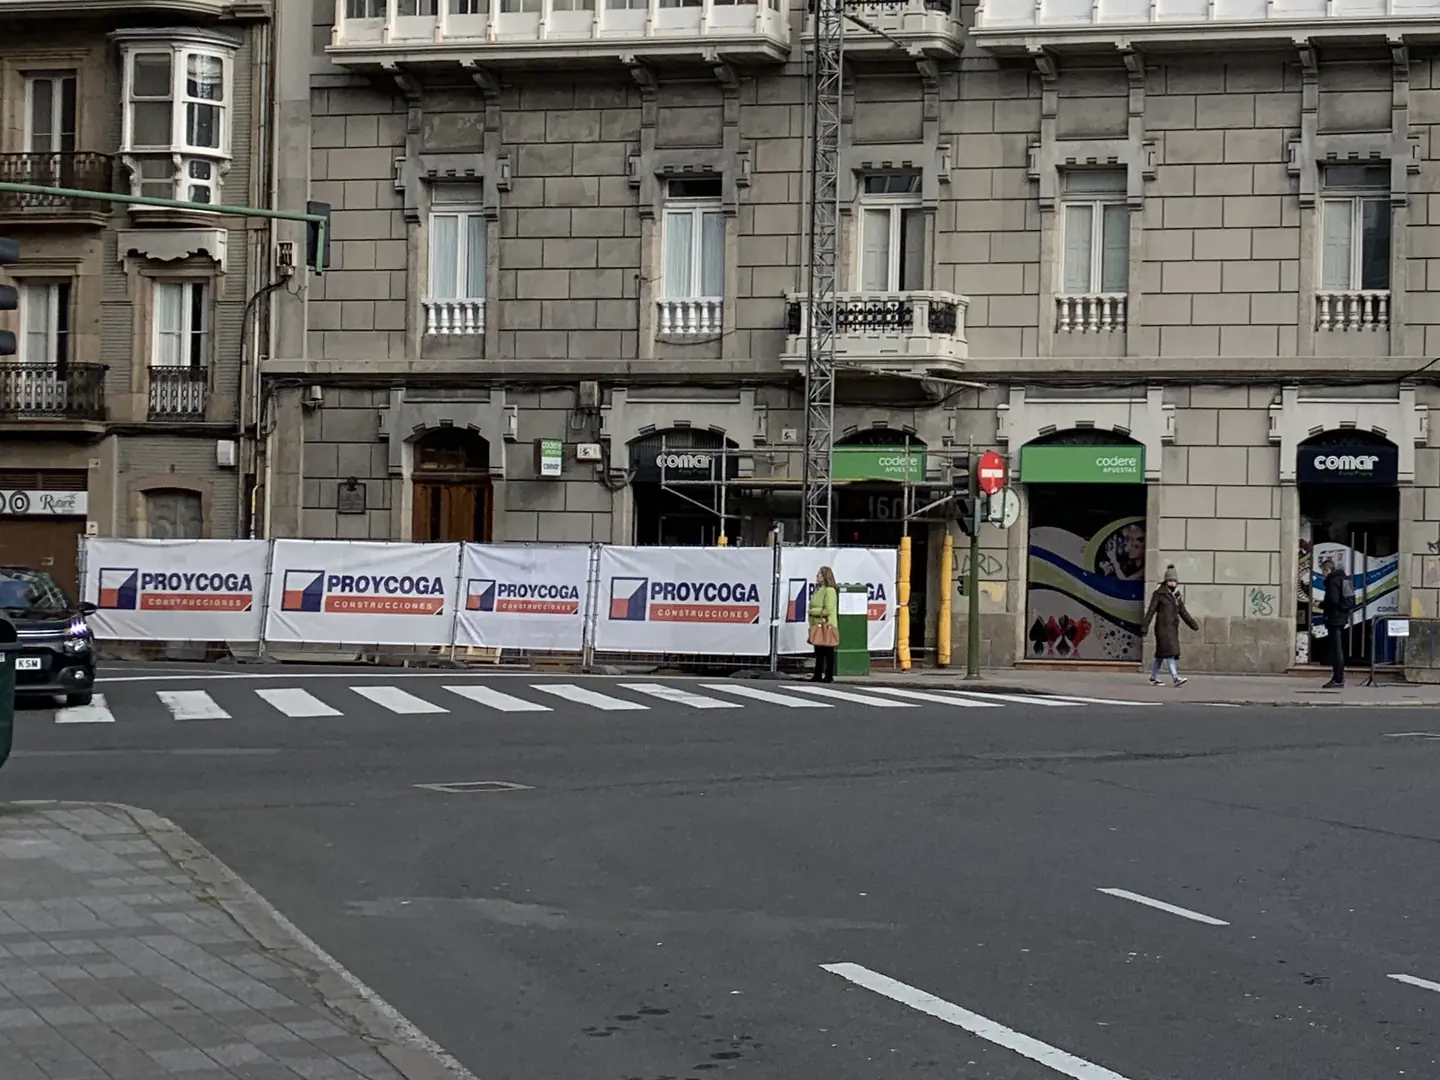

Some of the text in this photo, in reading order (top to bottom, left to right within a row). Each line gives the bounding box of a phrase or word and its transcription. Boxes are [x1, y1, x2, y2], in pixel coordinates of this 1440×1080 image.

[656, 454, 712, 469] comar
[1096, 456, 1137, 467] codere
[1314, 455, 1379, 470] comar
[141, 572, 252, 592] PROYCOGA
[327, 575, 444, 595] PROYCOGA
[498, 583, 579, 600] PROYCOGA
[650, 582, 760, 602] PROYCOGA
[148, 598, 241, 607] CONSTRUCCIONES
[334, 601, 433, 610] CONSTRUCCIONES
[502, 602, 572, 611] CONSTRUCCIONES
[657, 609, 749, 618] CONSTRUCCIONES
